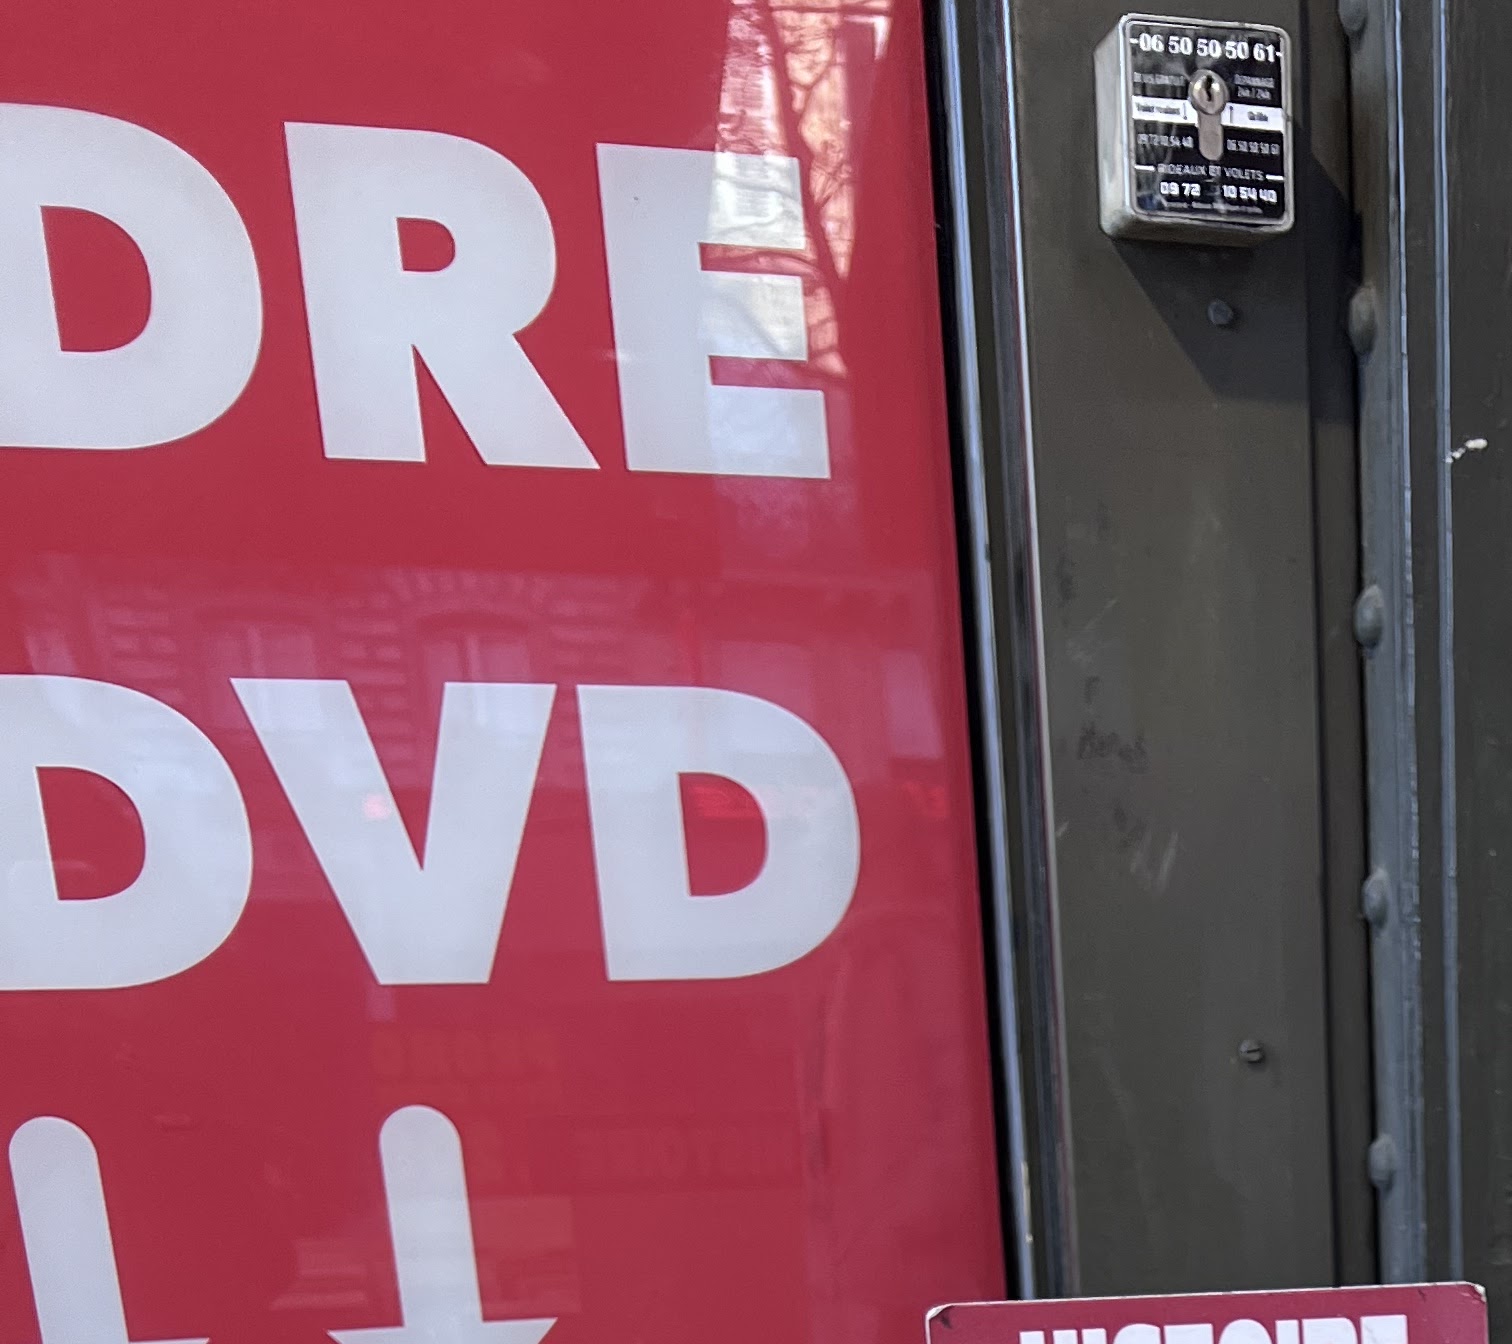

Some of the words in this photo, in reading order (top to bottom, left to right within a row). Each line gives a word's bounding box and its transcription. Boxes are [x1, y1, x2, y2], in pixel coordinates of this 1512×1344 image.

[1168, 35, 1192, 55] 50
[1197, 38, 1222, 57] 50
[1225, 40, 1249, 60] 50
[1224, 167, 1265, 181] VOLETS
[0, 103, 830, 479] DRE
[0, 673, 861, 990] DVD
